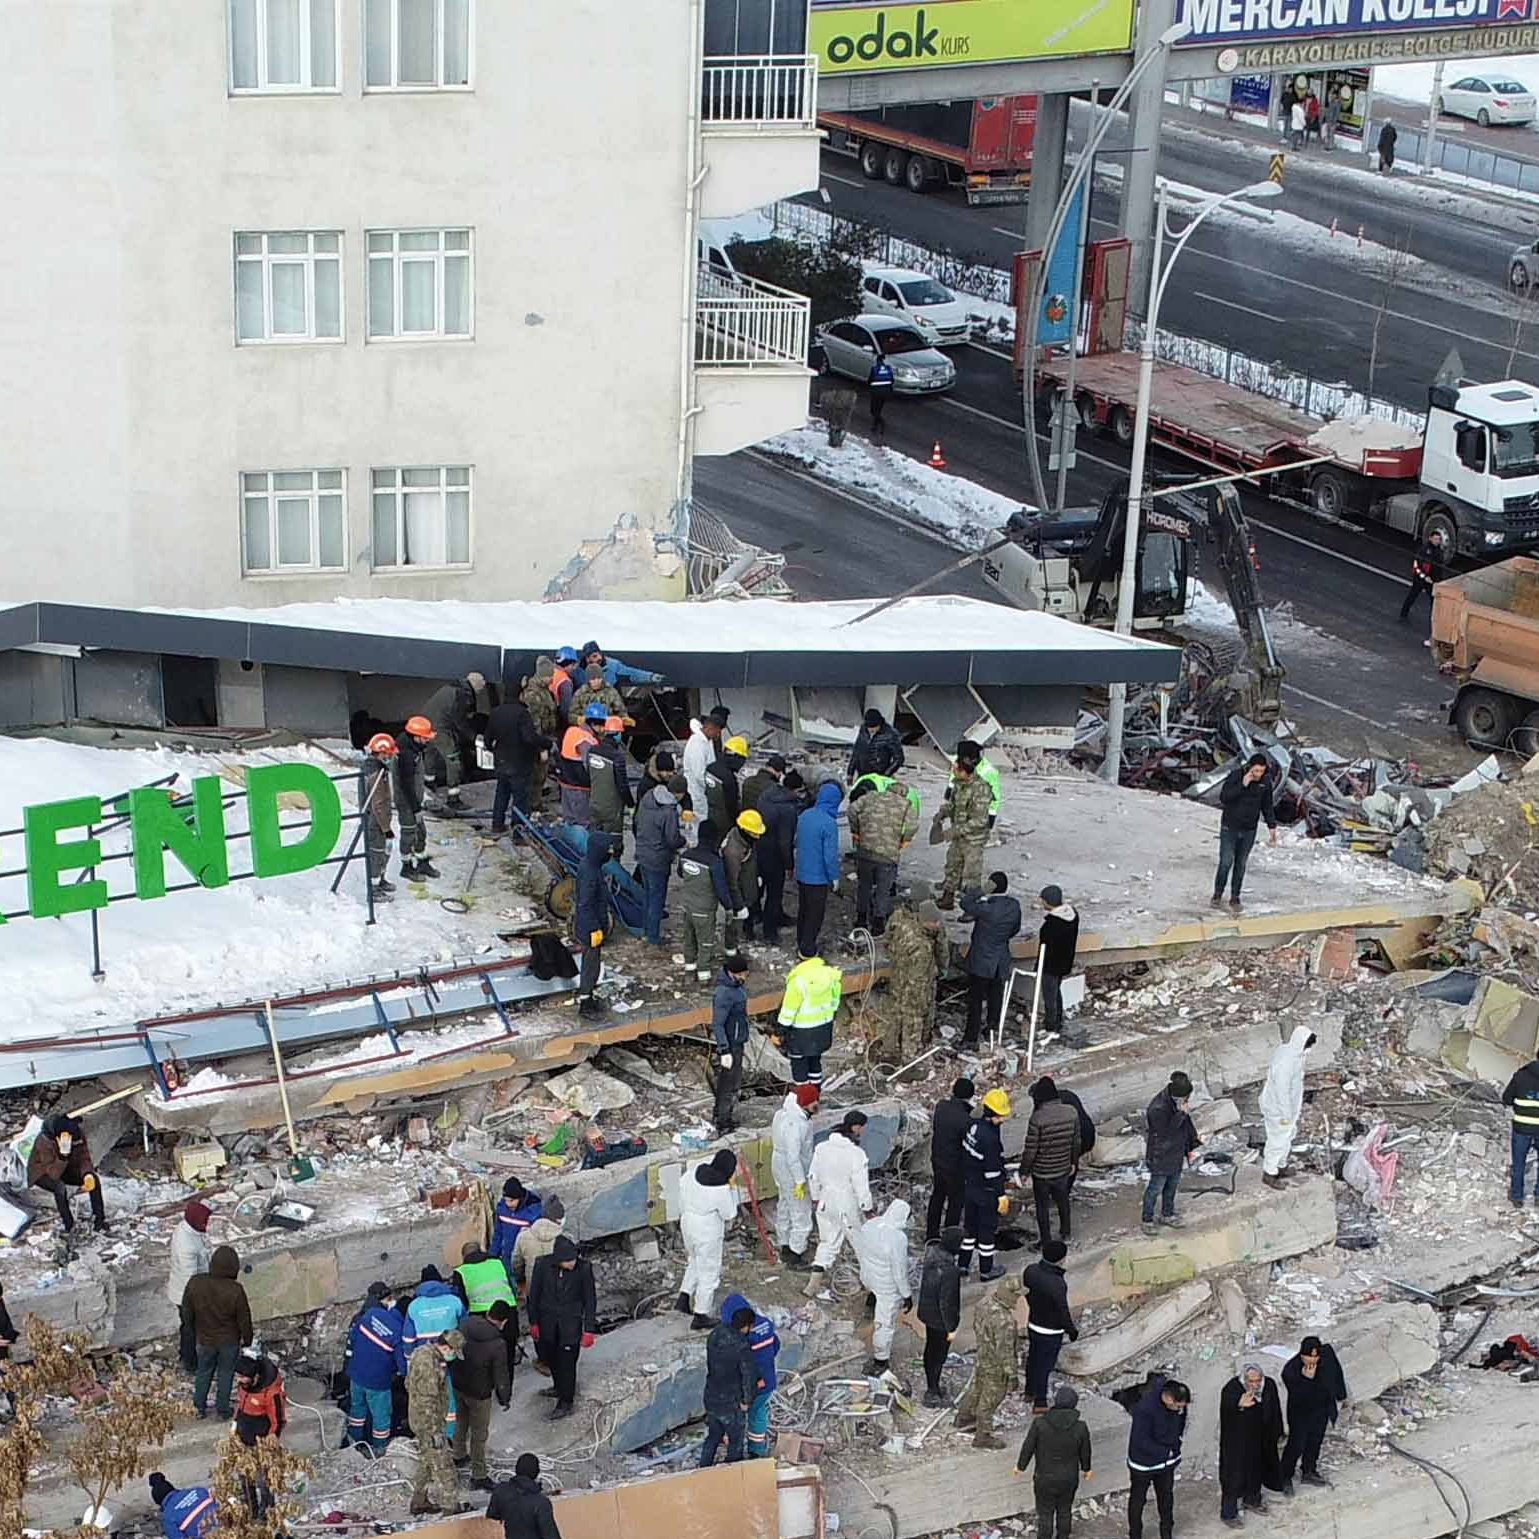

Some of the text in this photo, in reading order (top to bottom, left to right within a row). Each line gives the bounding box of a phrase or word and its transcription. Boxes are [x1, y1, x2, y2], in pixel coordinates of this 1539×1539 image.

[1182, 0, 1349, 34] MERCAN
[827, 9, 970, 63] odak KURS
[1244, 40, 1375, 67] KARAYOLLARI
